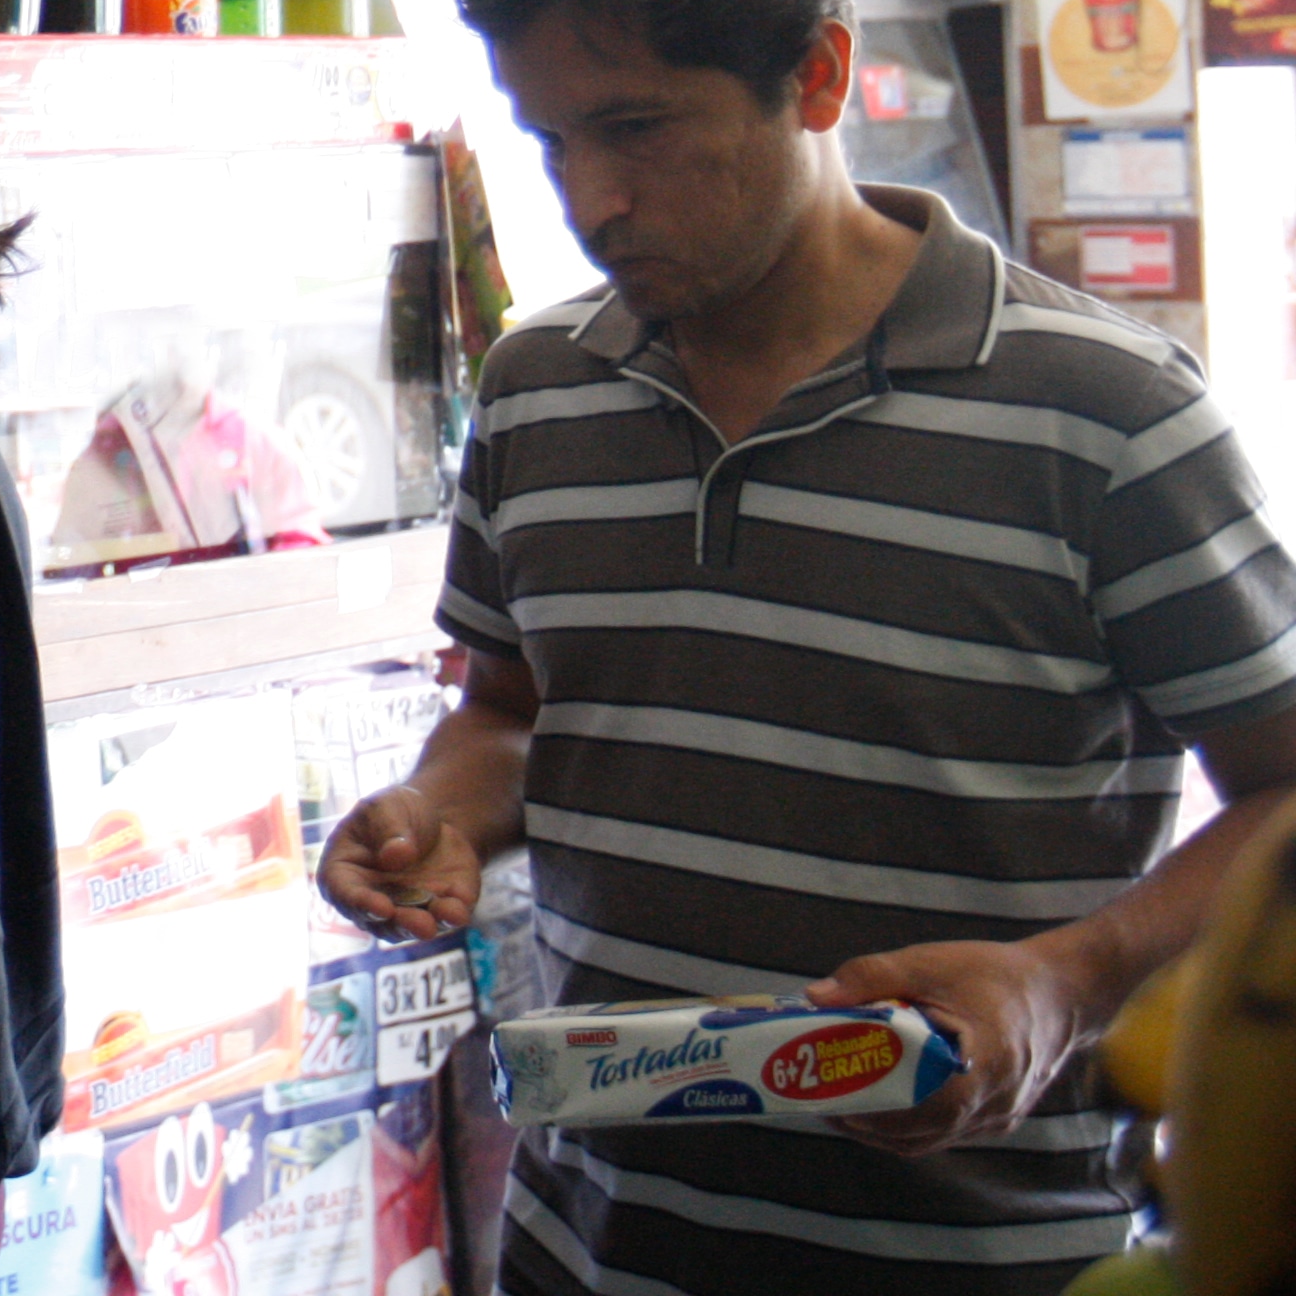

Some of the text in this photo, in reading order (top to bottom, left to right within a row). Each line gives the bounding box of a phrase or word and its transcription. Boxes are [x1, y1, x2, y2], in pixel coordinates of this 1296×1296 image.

[382, 974, 398, 1015] 3
[566, 1028, 619, 1047] BIMBO
[90, 1036, 215, 1117] Butterfield
[585, 1028, 728, 1090] Tostadas
[772, 1043, 817, 1090] 6+2
[816, 1028, 889, 1061] Rebanadas
[818, 1048, 895, 1085] GRATIS
[683, 1087, 748, 1109] Clásicas
